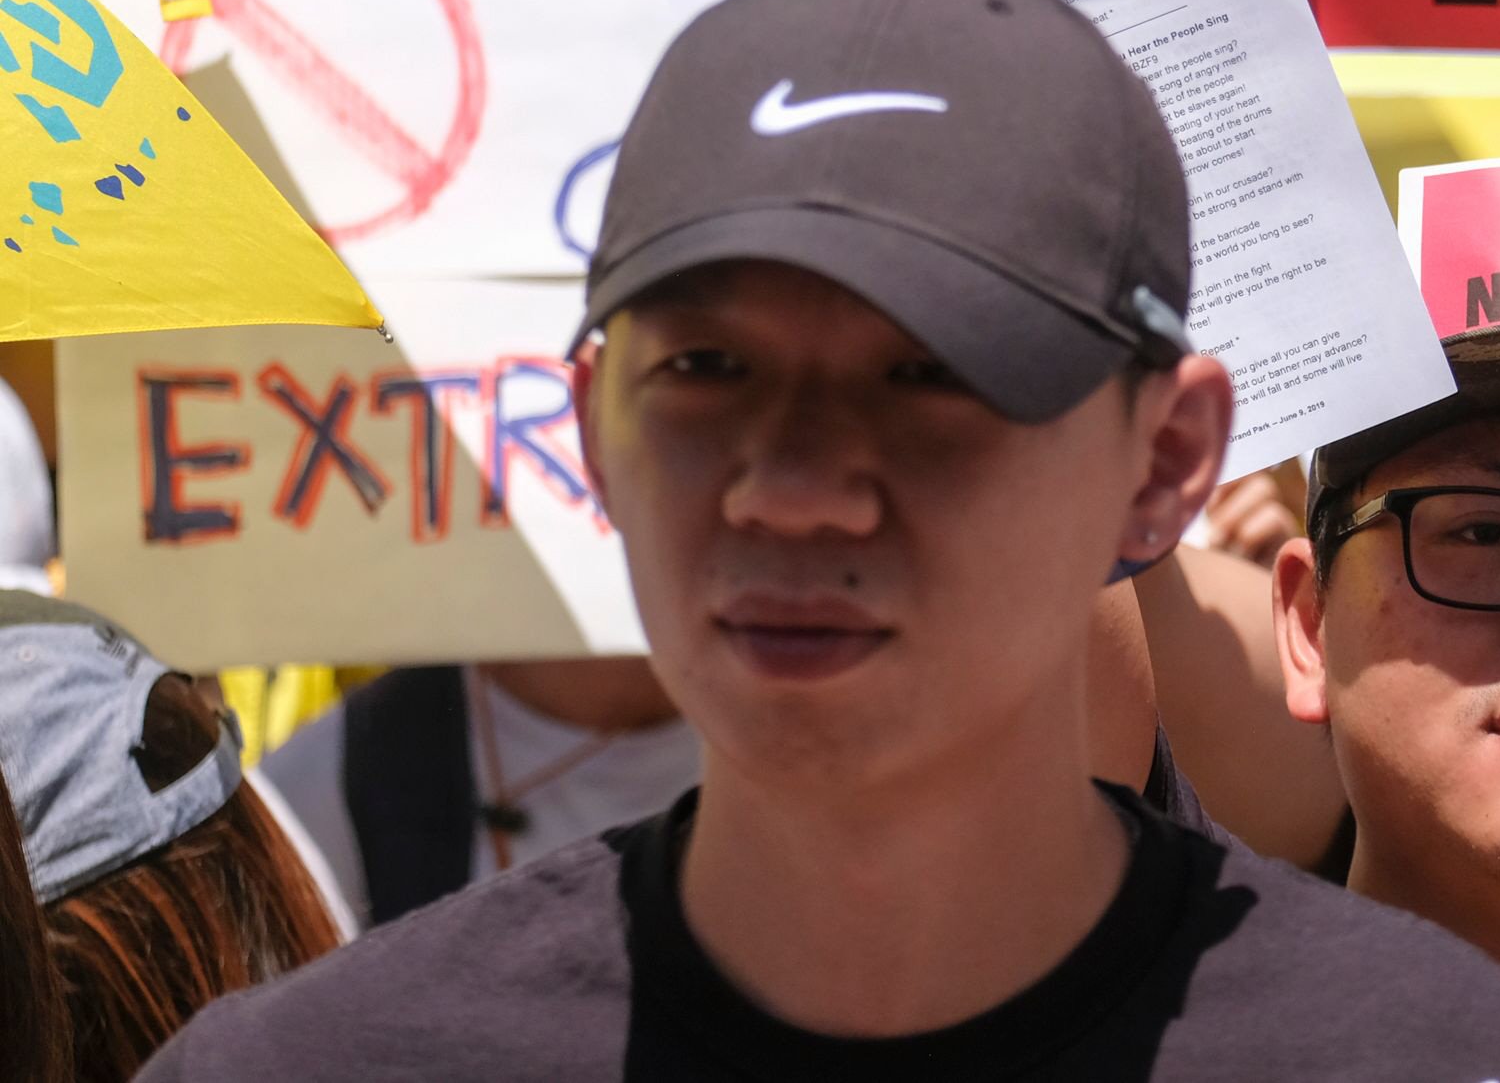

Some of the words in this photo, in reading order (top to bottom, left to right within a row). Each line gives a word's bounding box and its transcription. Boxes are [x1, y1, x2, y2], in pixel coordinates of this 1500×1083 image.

[1127, 42, 1151, 57] Hear
[1152, 36, 1169, 48] the
[1169, 22, 1204, 41] People
[1205, 13, 1229, 27] Sing
[1158, 78, 1183, 93] song
[1183, 71, 1193, 83] of
[1194, 63, 1220, 79] angry
[1221, 51, 1247, 68] men?
[1163, 63, 1180, 75] the
[1181, 50, 1213, 70] people
[1213, 39, 1238, 56] sing?
[1172, 108, 1186, 119] be
[1187, 96, 1218, 113] slaves
[1218, 83, 1246, 101] again!
[1175, 90, 1185, 102] of
[1185, 86, 1202, 98] the
[1203, 73, 1234, 93] people
[1202, 111, 1213, 123] of
[1213, 104, 1234, 121] your
[1235, 94, 1261, 110] heart
[1180, 129, 1215, 148] beating
[1215, 121, 1226, 134] of
[1226, 118, 1242, 130] the
[1242, 106, 1272, 123] drums
[1195, 140, 1223, 157] about
[1222, 137, 1233, 146] to
[1233, 127, 1256, 142] start
[1211, 146, 1245, 167] comes!
[1192, 209, 1206, 221] be
[1207, 198, 1237, 215] strong
[1238, 189, 1256, 203] and
[1257, 178, 1283, 196] stand
[1283, 172, 1304, 185] with
[1202, 191, 1214, 200] in
[1215, 184, 1230, 196] our
[1232, 166, 1273, 190] crusade?
[1200, 237, 1216, 249] the
[1216, 220, 1261, 242] barricade
[1205, 254, 1213, 263] a
[1212, 242, 1239, 259] world
[1239, 237, 1258, 251] you
[1258, 228, 1280, 242] long
[1280, 224, 1291, 234] to
[1291, 213, 1314, 229] see?
[1203, 282, 1223, 297] join
[1222, 277, 1233, 287] in
[1233, 271, 1250, 283] the
[1250, 261, 1272, 277] fight
[1206, 295, 1223, 308] will
[1223, 289, 1245, 305] give
[1244, 281, 1263, 297] you
[1263, 275, 1280, 287] the
[1280, 265, 1303, 280] right
[1302, 262, 1313, 272] to
[1313, 257, 1327, 268] be
[1229, 366, 1248, 381] you
[1248, 358, 1269, 373] give
[1270, 351, 1282, 363] all
[1282, 345, 1301, 360] you
[1302, 338, 1320, 351] can
[1320, 330, 1341, 346] give
[1250, 374, 1266, 386] our
[1267, 361, 1300, 380] banner
[1302, 352, 1322, 366] may
[1323, 333, 1367, 358] advance?
[1249, 388, 1266, 401] will
[1266, 382, 1282, 396] fall
[1282, 374, 1302, 389] and
[1302, 366, 1328, 382] some
[1329, 358, 1345, 371] will
[1345, 353, 1363, 365] live
[1251, 421, 1271, 434] Park
[1278, 412, 1298, 424] June
[1298, 408, 1307, 416] 9,
[1306, 400, 1325, 413] 2019
